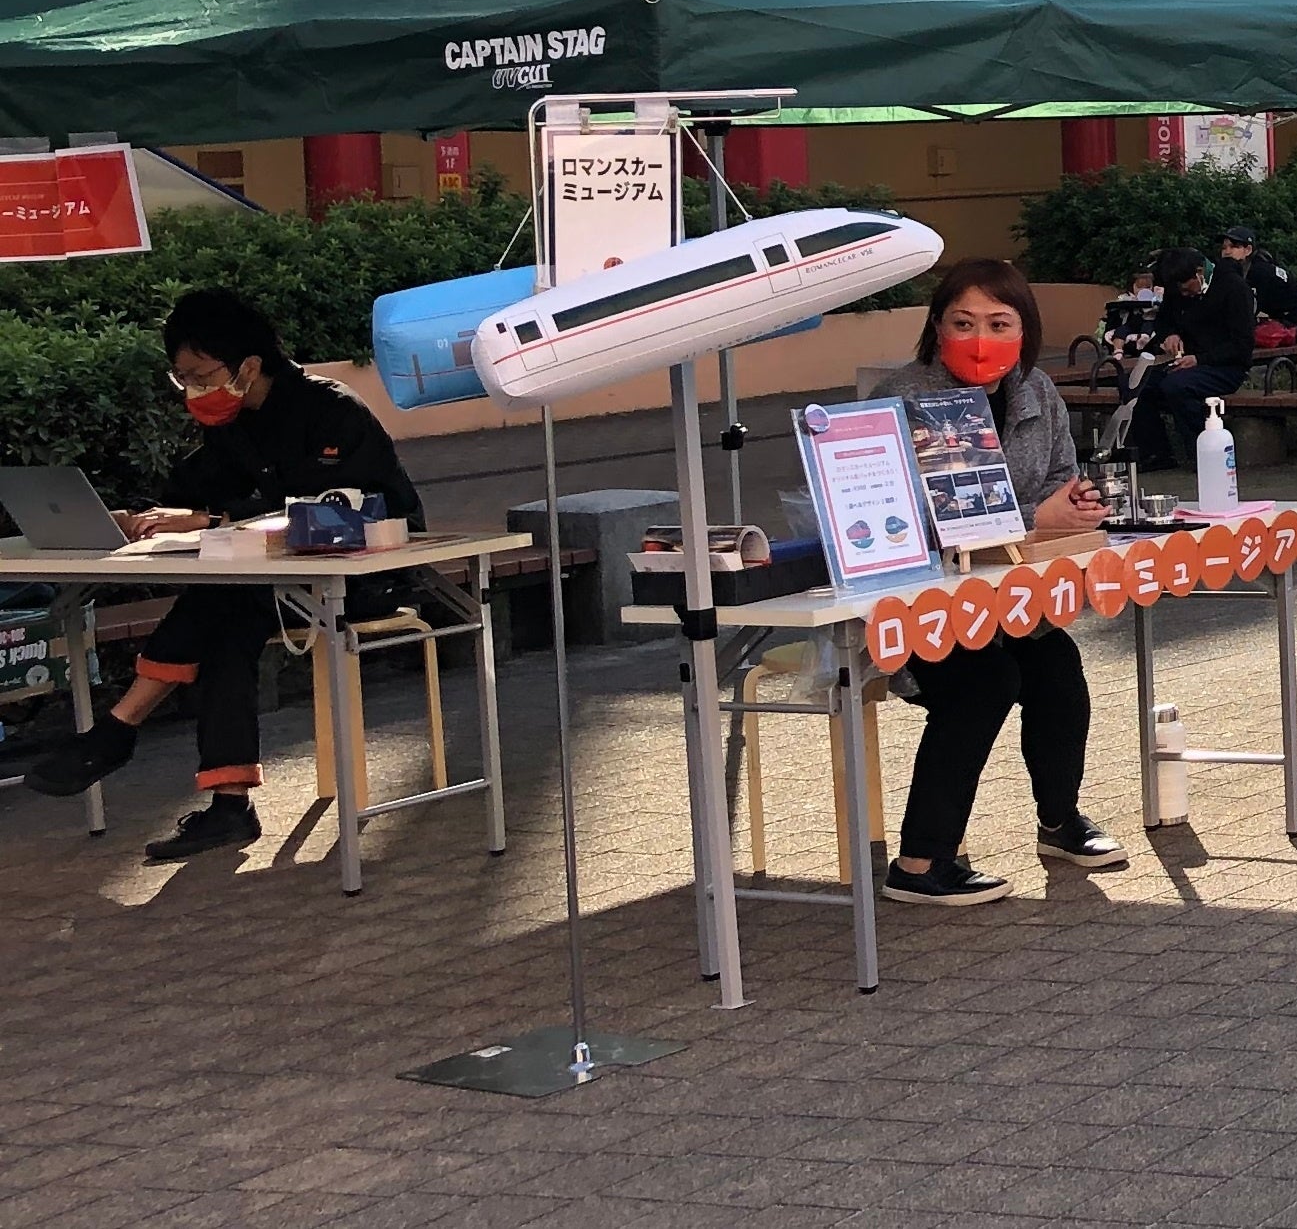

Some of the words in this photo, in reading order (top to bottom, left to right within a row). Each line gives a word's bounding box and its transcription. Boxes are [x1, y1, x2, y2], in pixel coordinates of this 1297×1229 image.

[444, 33, 543, 70] CAPTAIN
[547, 26, 607, 60] STAG
[562, 157, 663, 177] ロマンスカー
[562, 181, 664, 202] ミュージアム
